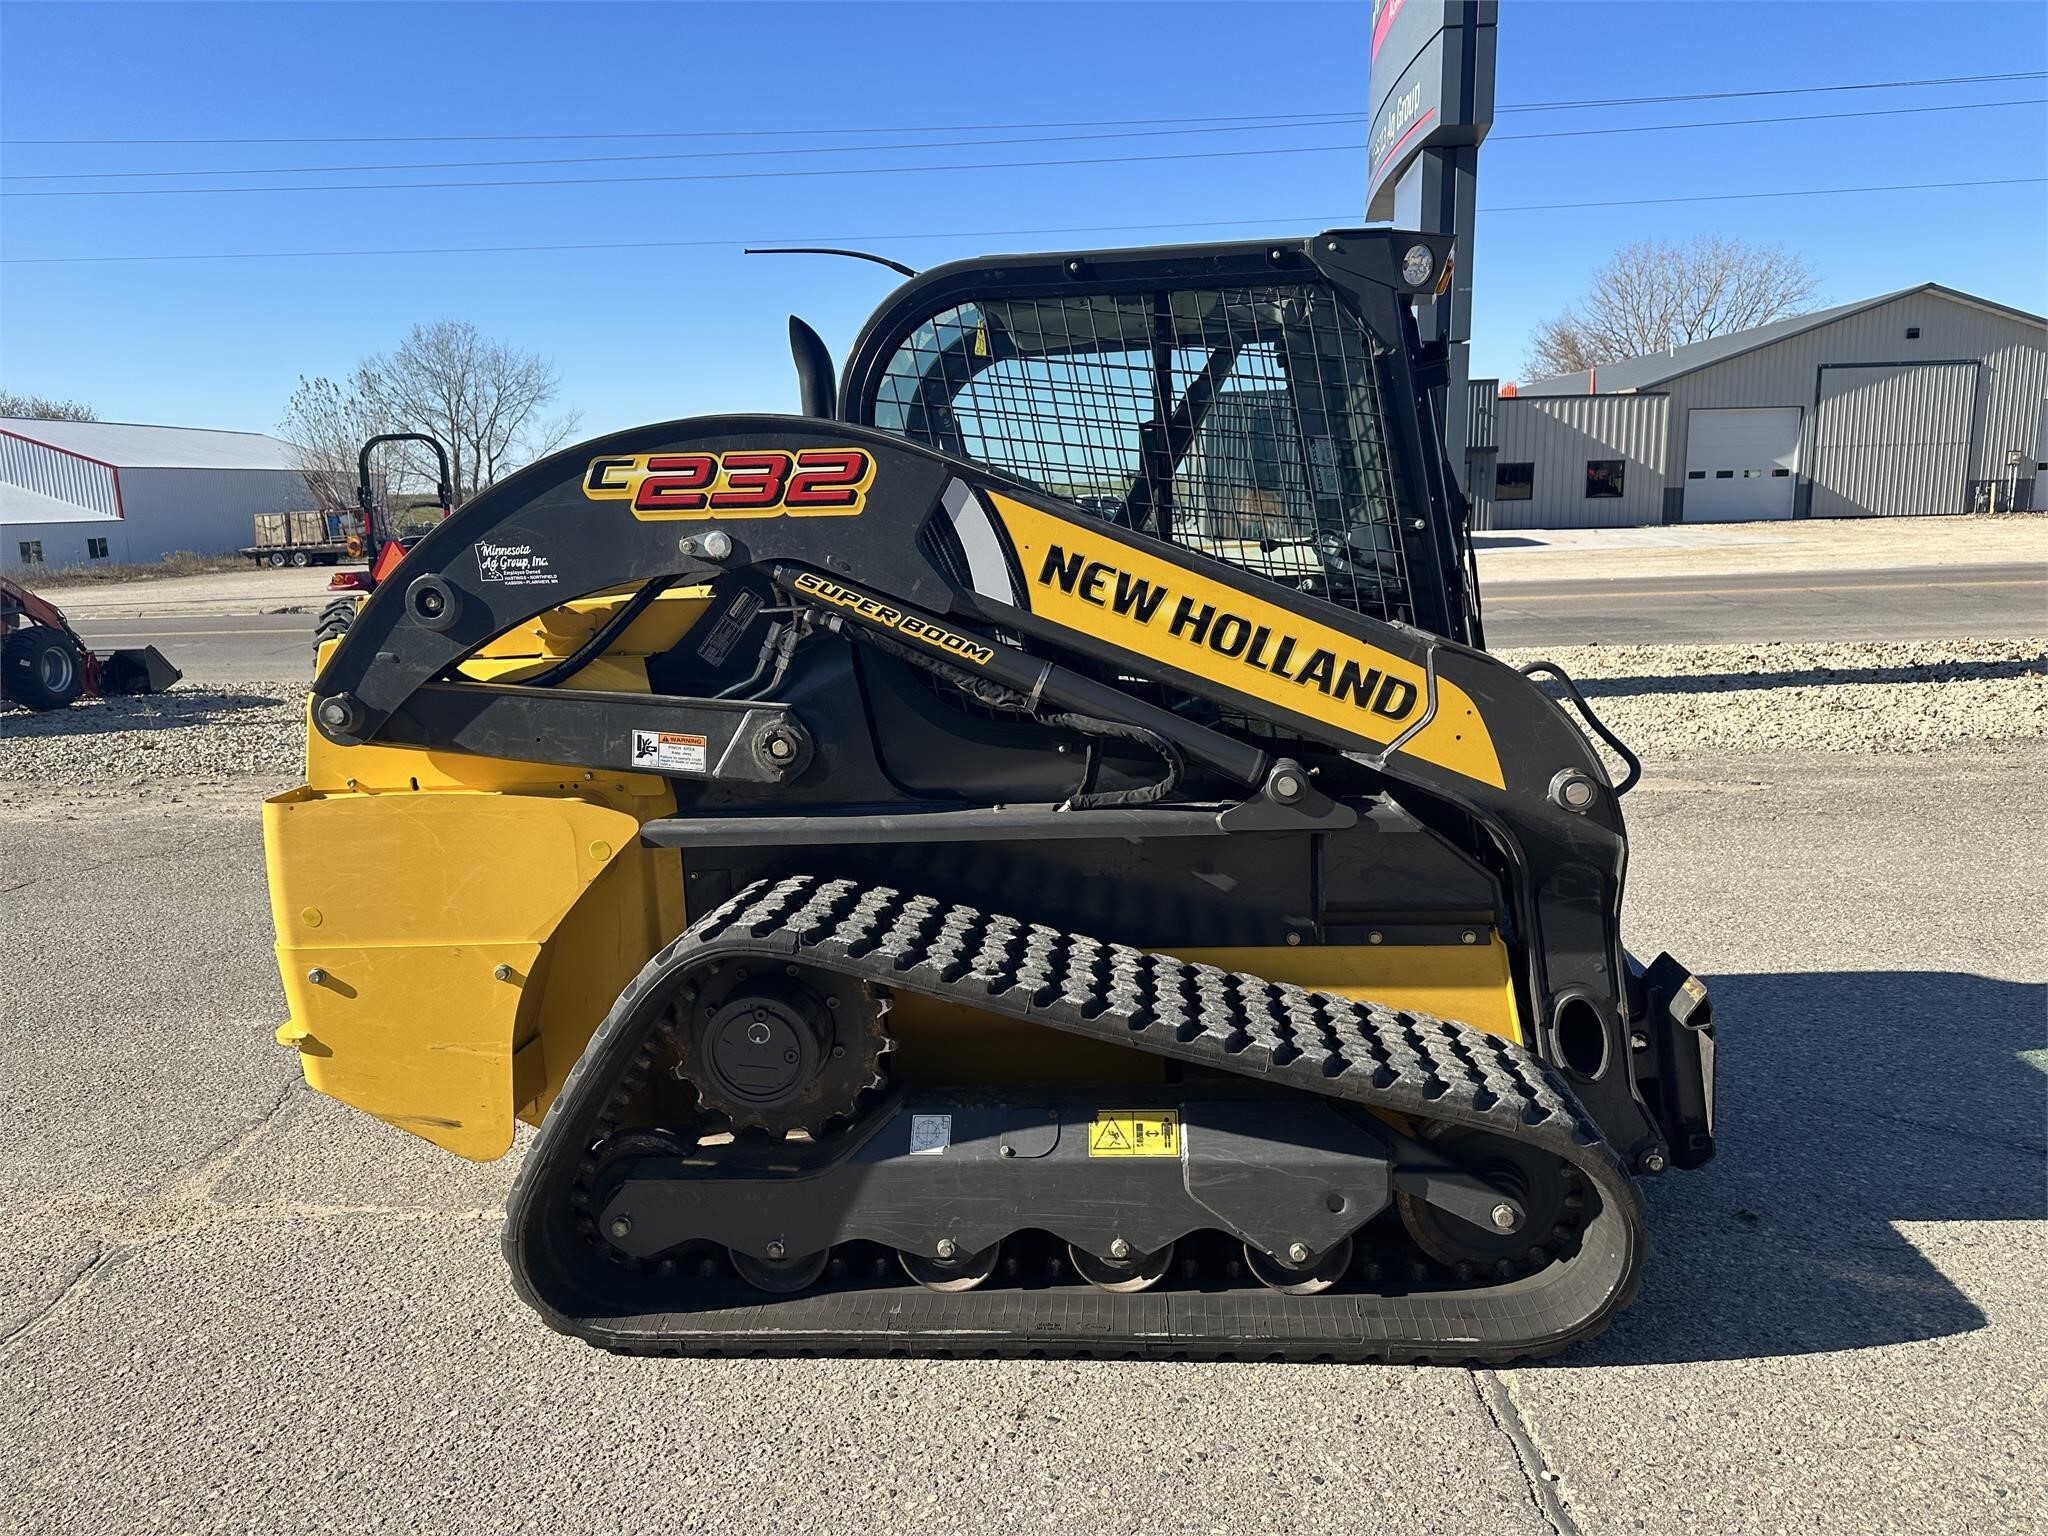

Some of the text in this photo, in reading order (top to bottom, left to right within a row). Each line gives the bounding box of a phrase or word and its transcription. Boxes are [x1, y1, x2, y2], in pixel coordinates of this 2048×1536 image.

[1396, 82, 1420, 132] Group
[586, 451, 871, 512] C232
[480, 544, 531, 556] Minnesota
[481, 556, 548, 571] Ag Group, Inc.
[796, 574, 994, 664] SUPER BOOM
[1038, 543, 1419, 722] NEW HOLLAND
[670, 736, 702, 744] WARNING
